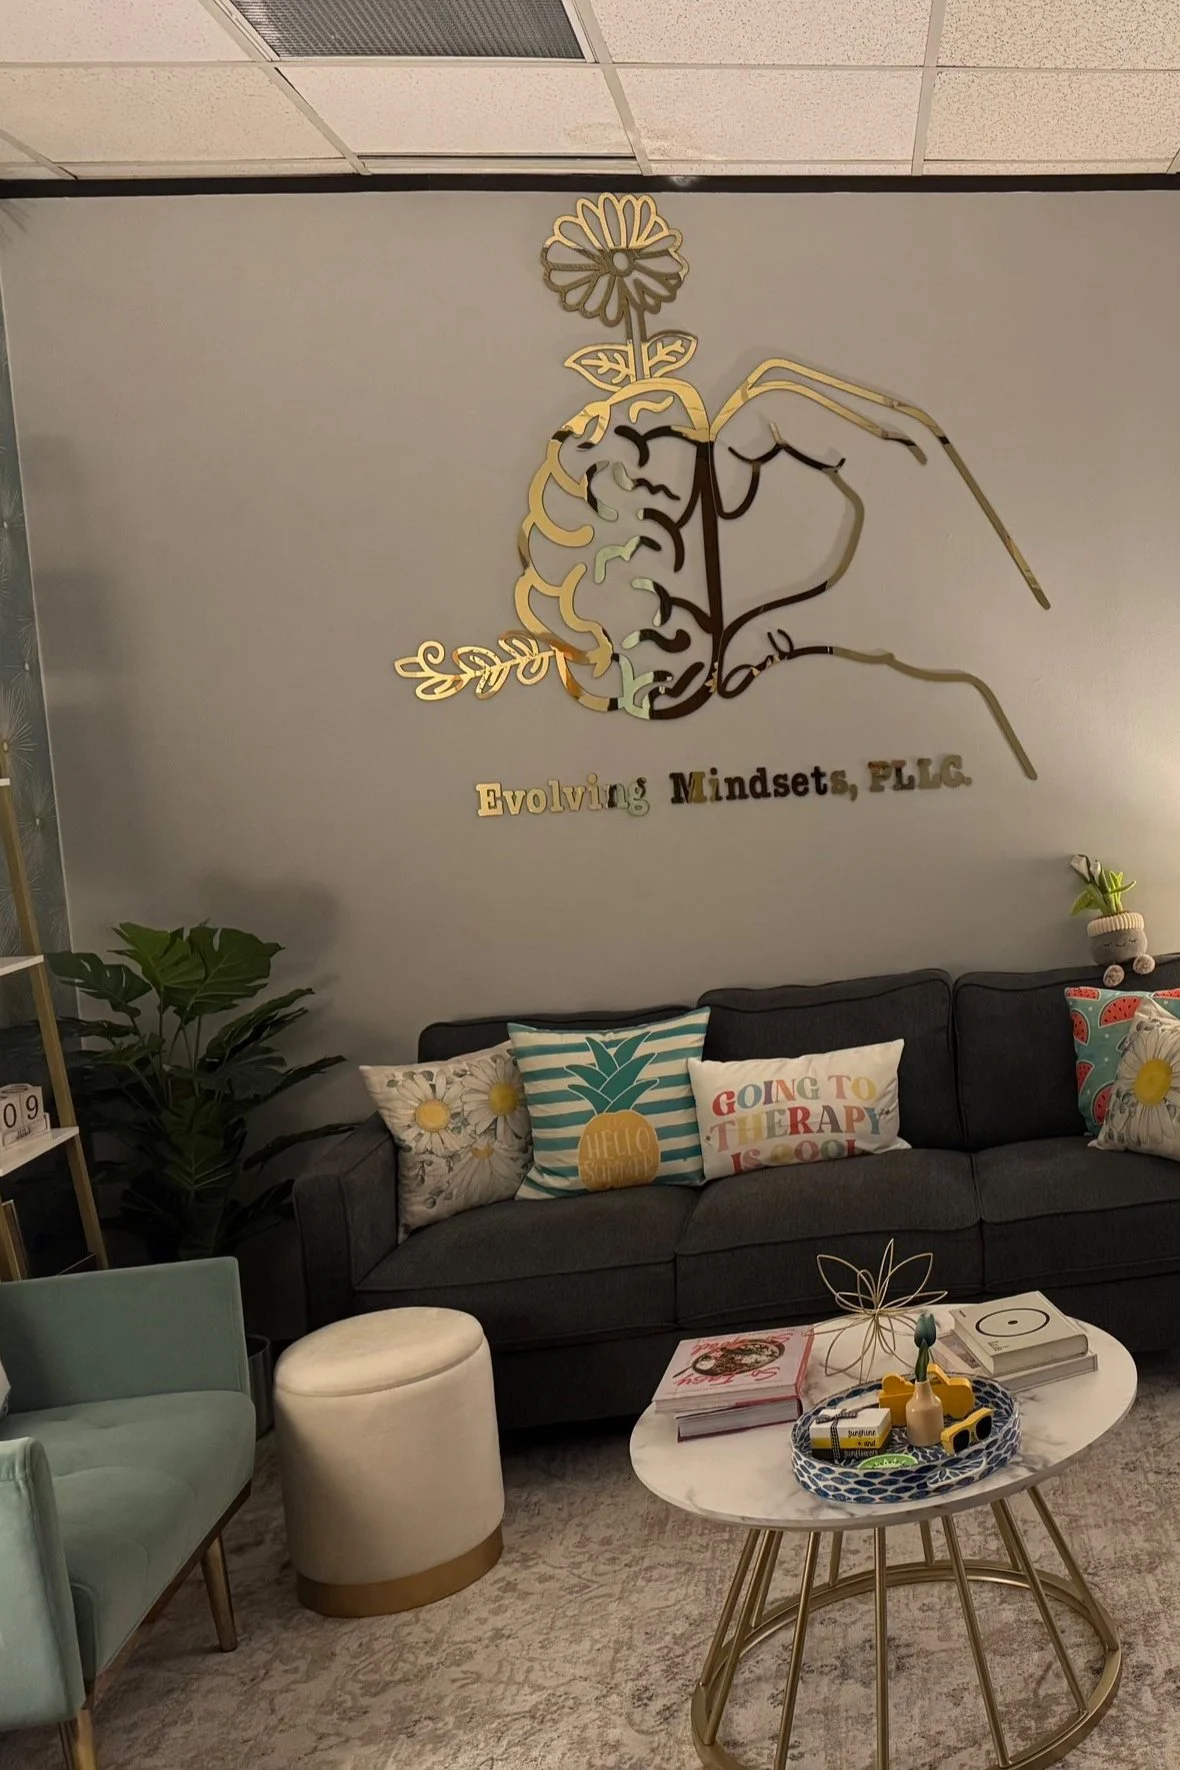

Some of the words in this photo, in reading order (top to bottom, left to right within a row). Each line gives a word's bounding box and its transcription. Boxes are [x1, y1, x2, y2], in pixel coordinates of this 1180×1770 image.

[475, 773, 651, 816] Evolving
[669, 765, 859, 803] Mindsets,
[867, 754, 973, 792] PLLC.
[711, 1076, 819, 1117] GOING
[828, 1074, 877, 1101] TO
[586, 1127, 651, 1159] HELLO
[710, 1105, 881, 1152] THERAPY
[731, 1149, 761, 1174] IS
[848, 1429, 876, 1438] sunshine
